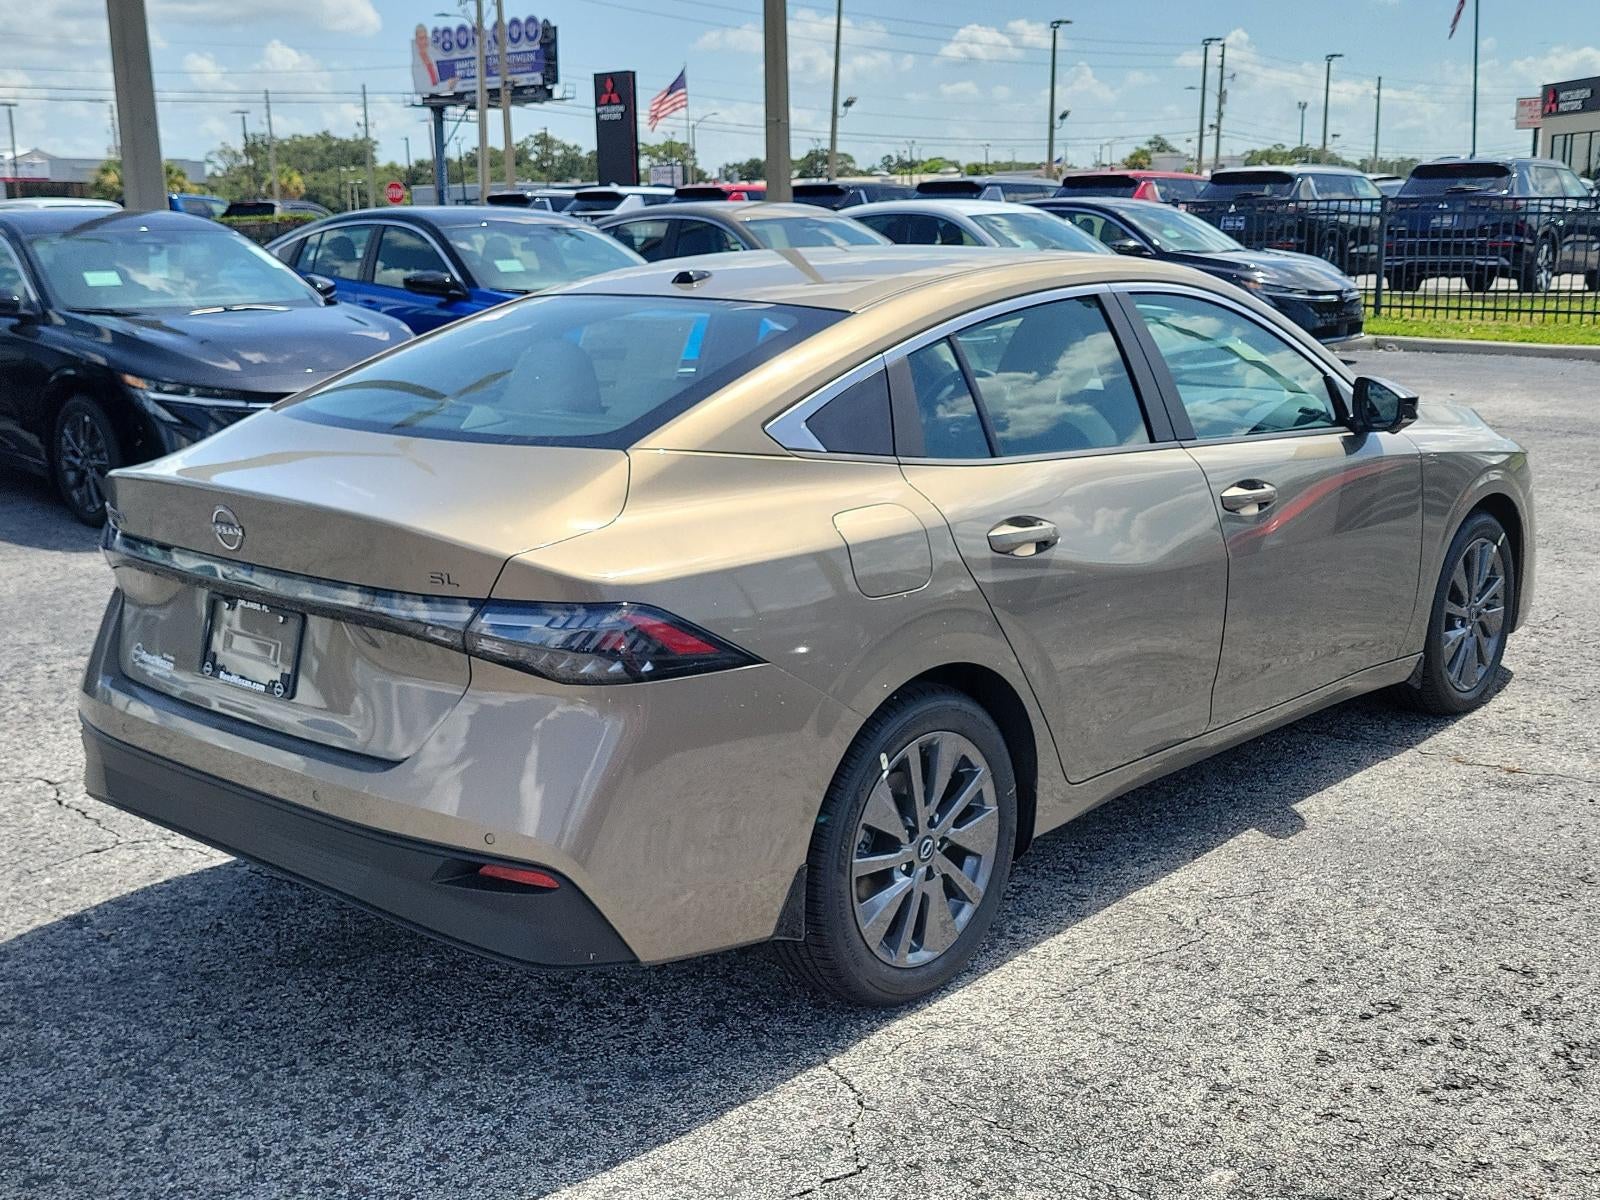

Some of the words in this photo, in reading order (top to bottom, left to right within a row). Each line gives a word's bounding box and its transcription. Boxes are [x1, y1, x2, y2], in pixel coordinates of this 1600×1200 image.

[599, 112, 622, 121] MOTORS
[387, 187, 404, 199] STOP
[429, 571, 460, 587] SL
